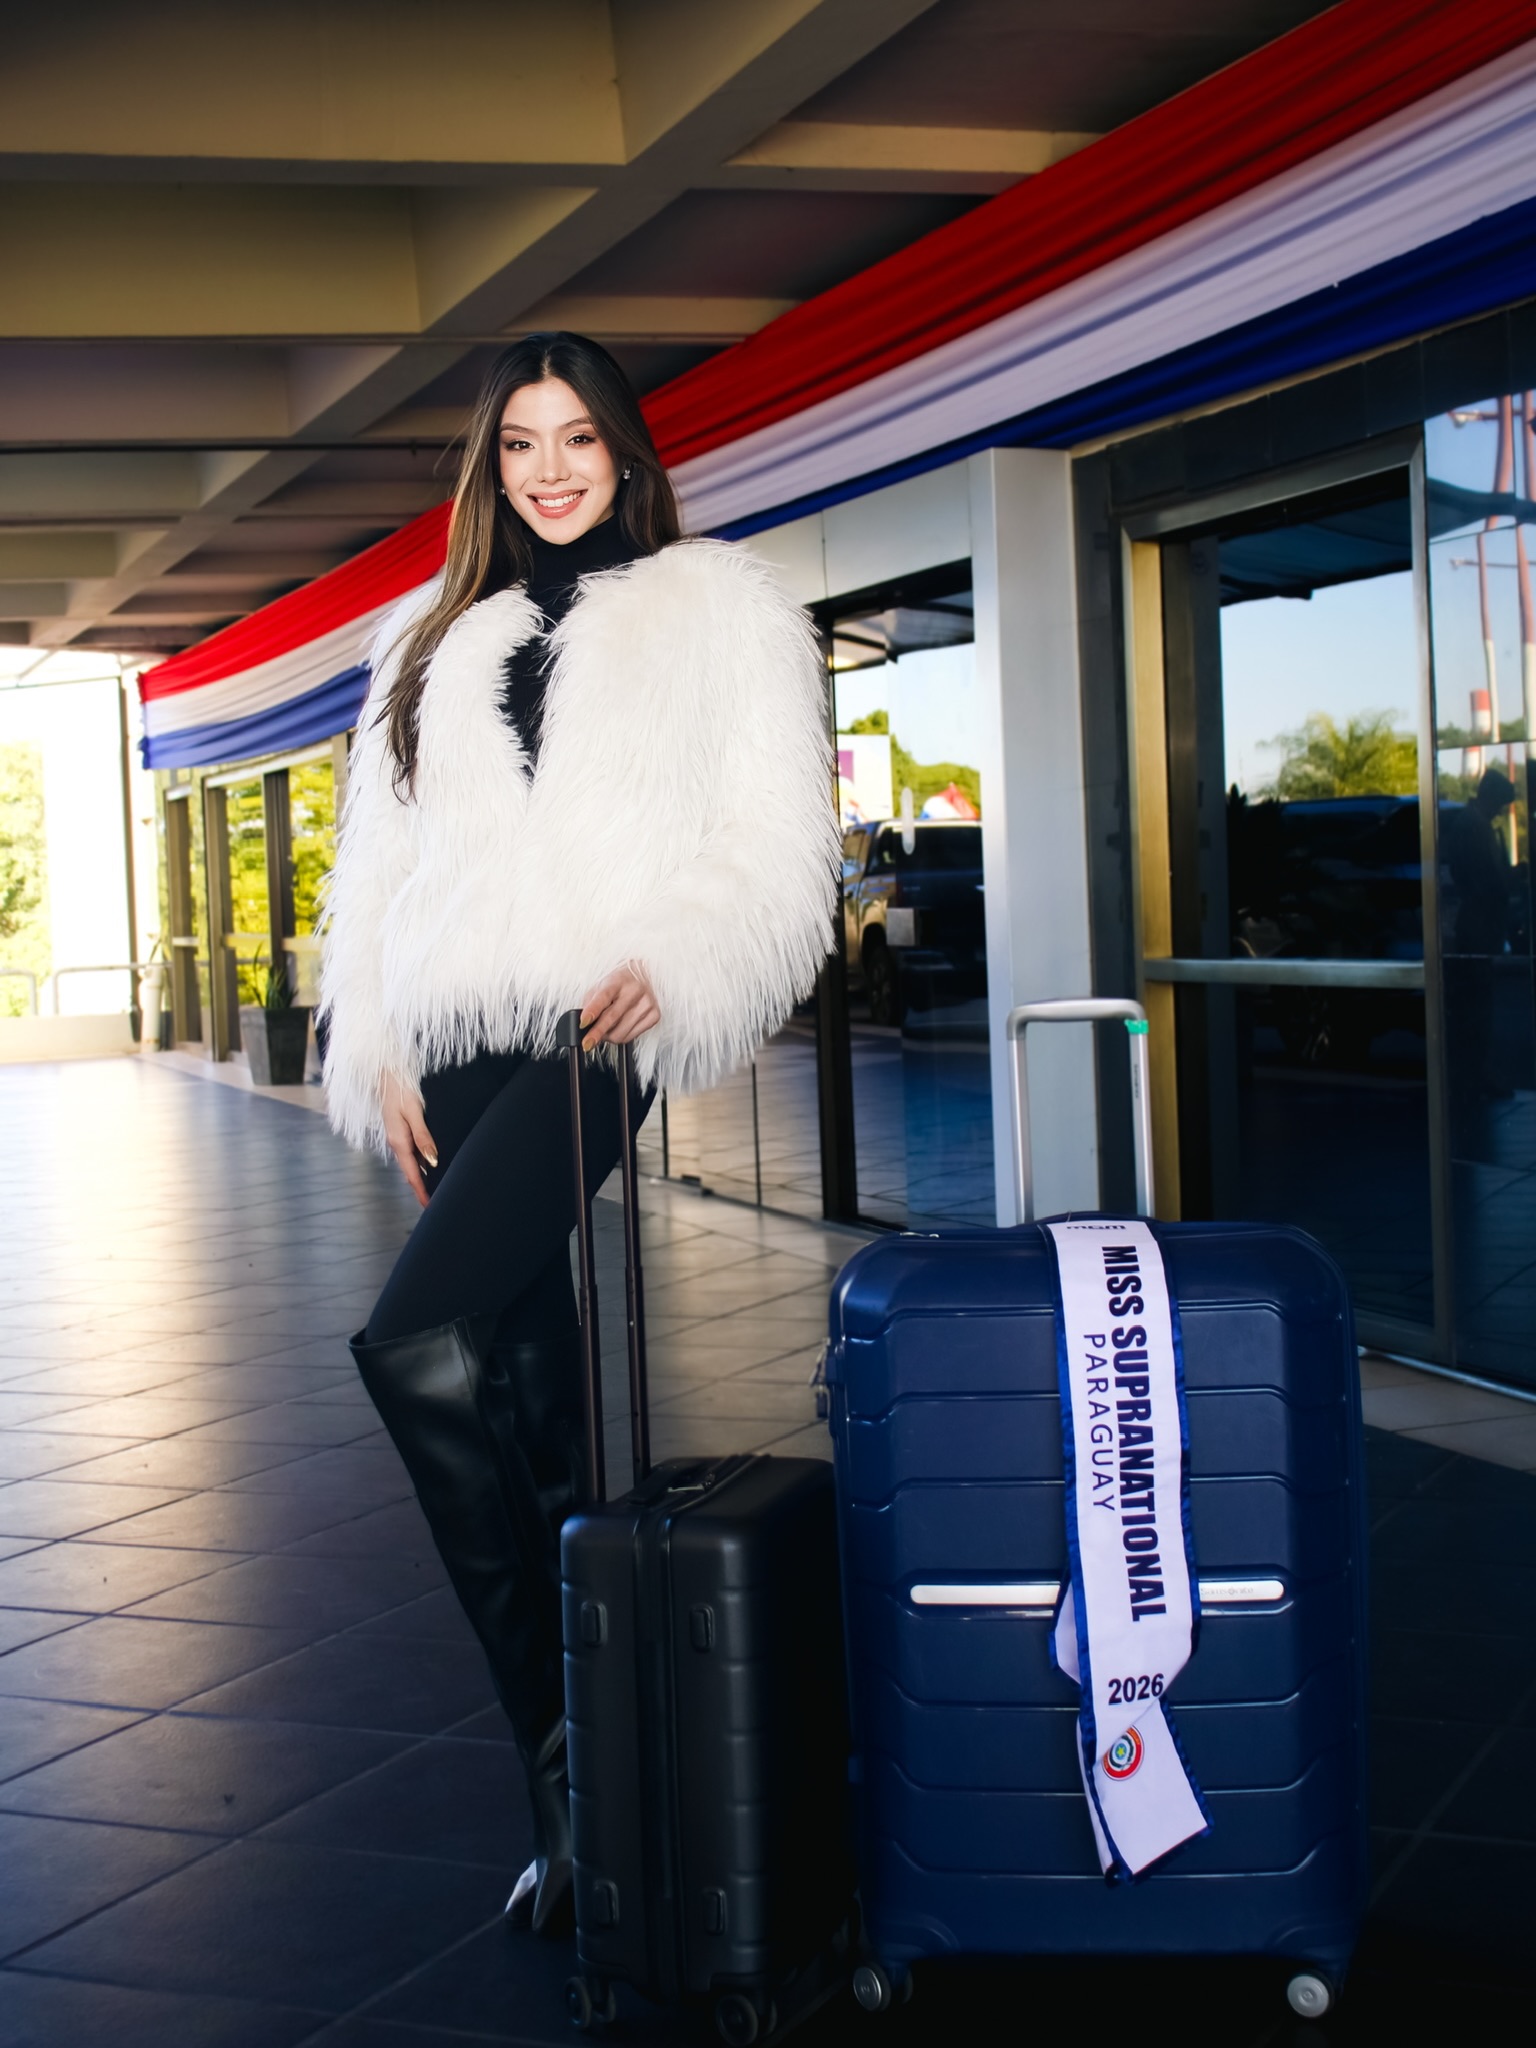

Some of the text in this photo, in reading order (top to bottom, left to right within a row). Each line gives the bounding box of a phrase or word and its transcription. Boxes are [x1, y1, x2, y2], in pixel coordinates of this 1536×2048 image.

[1083, 1334, 1115, 1511] PARAGUAY
[1102, 1246, 1167, 1622] MISS SUPRANATIONAL
[1108, 1673, 1164, 1706] 2026
